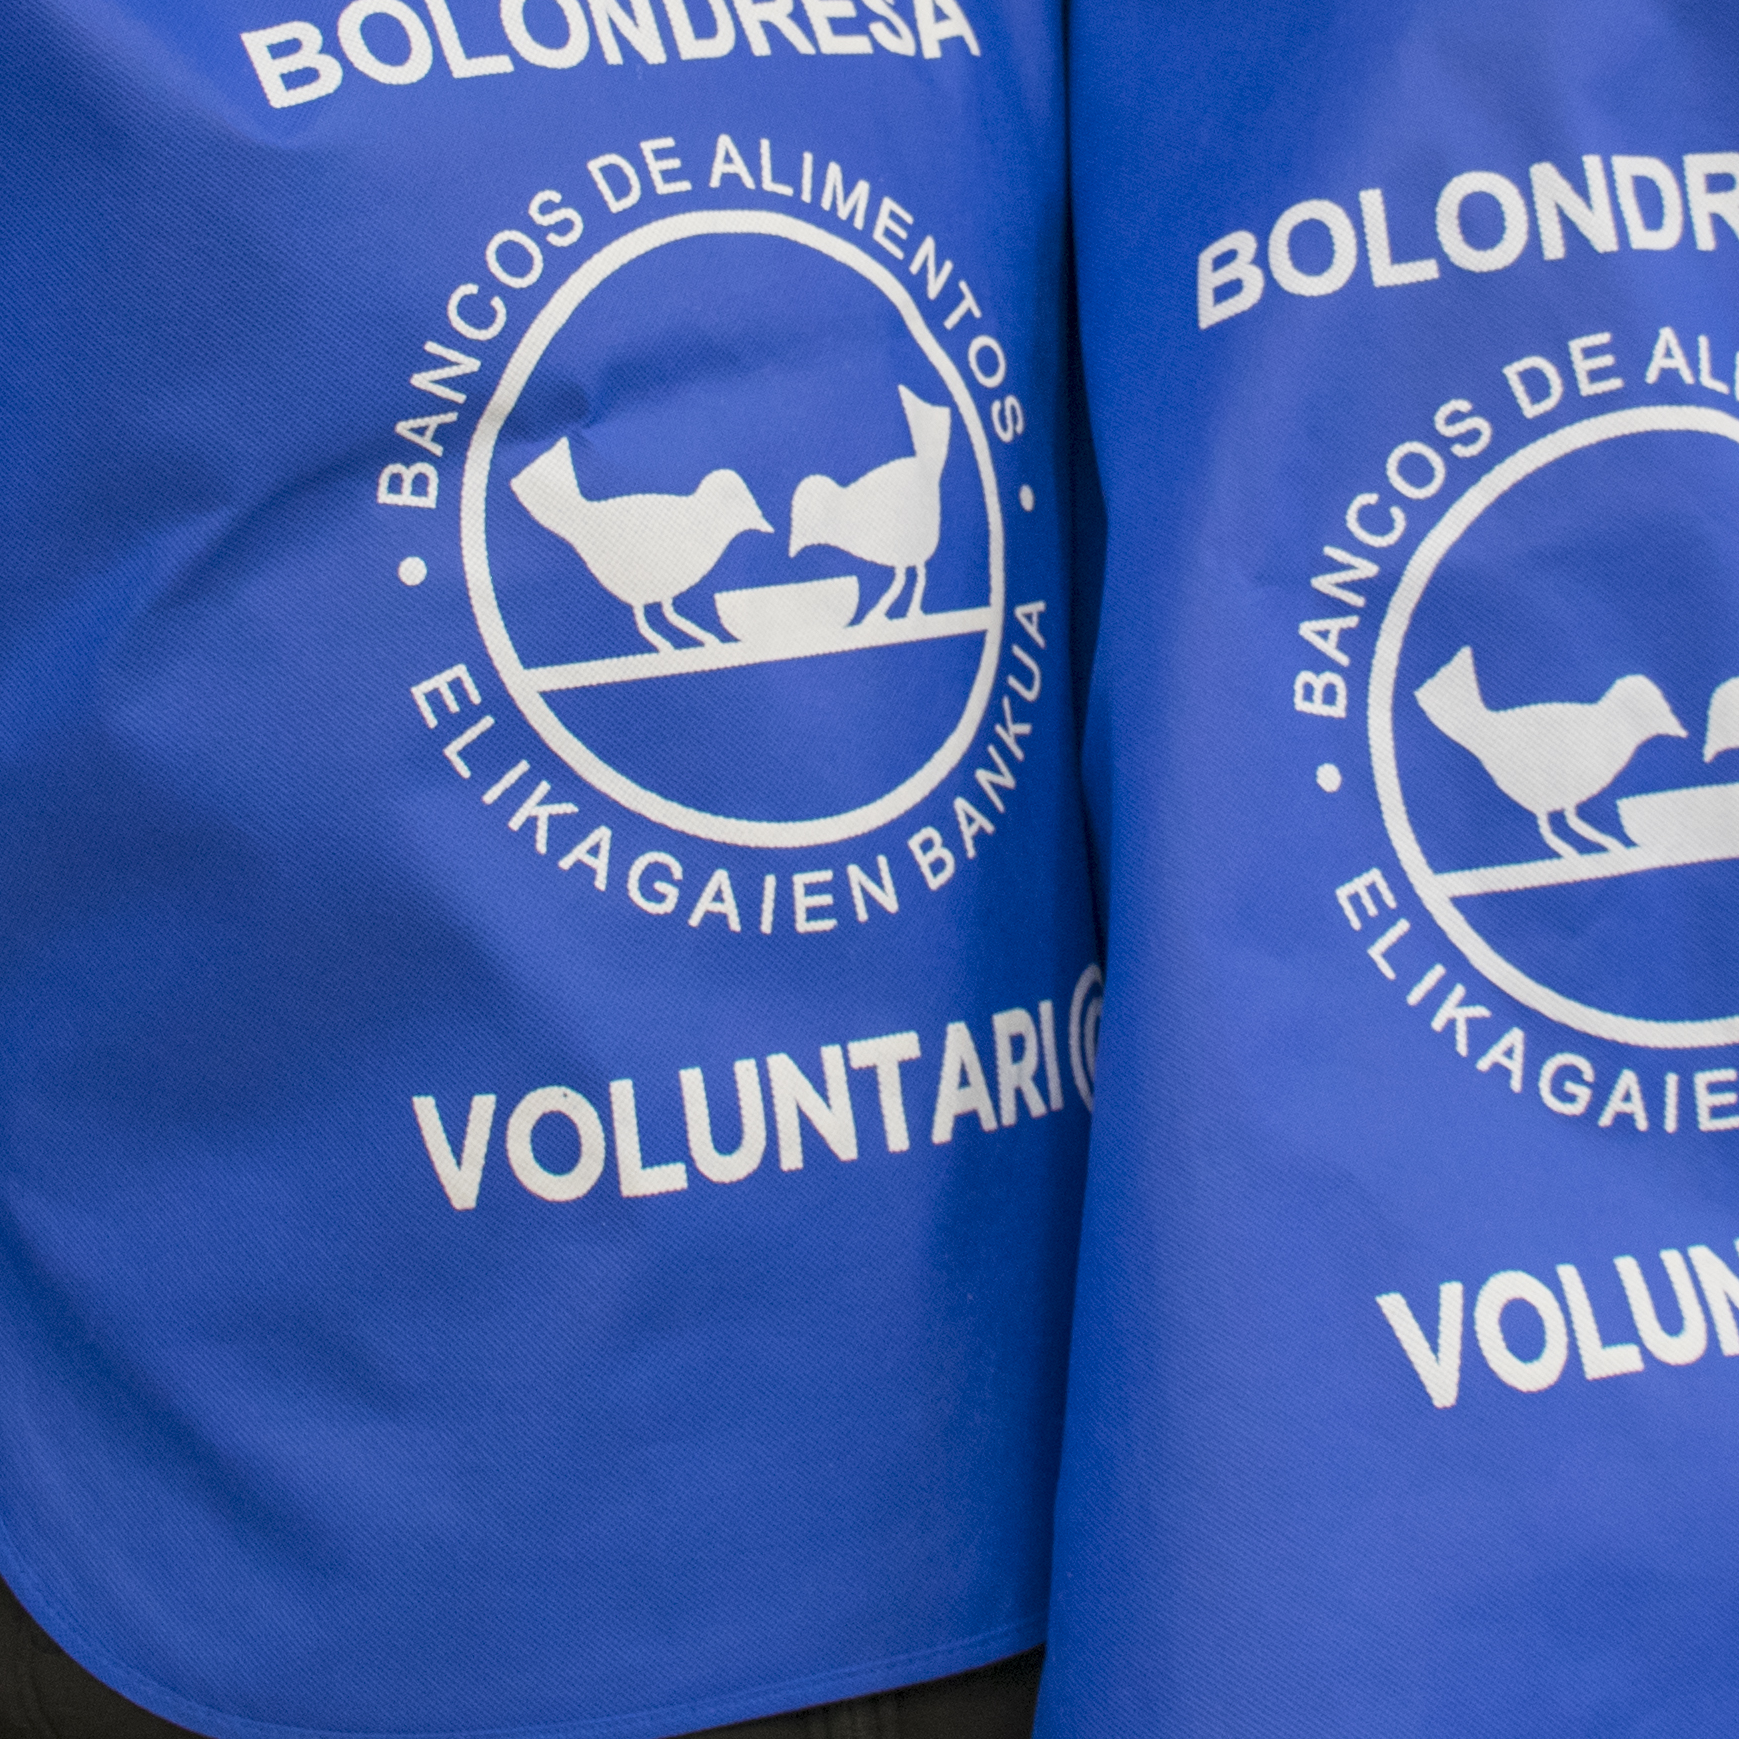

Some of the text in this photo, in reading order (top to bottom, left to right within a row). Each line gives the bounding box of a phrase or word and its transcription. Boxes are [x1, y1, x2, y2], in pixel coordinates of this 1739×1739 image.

[376, 133, 1024, 509] BANCOS DE ALIMENTOS
[1293, 398, 1493, 719] BANCOS
[1502, 331, 1625, 419] DE
[410, 600, 1048, 935] ELIKAGAIEN BANKUA
